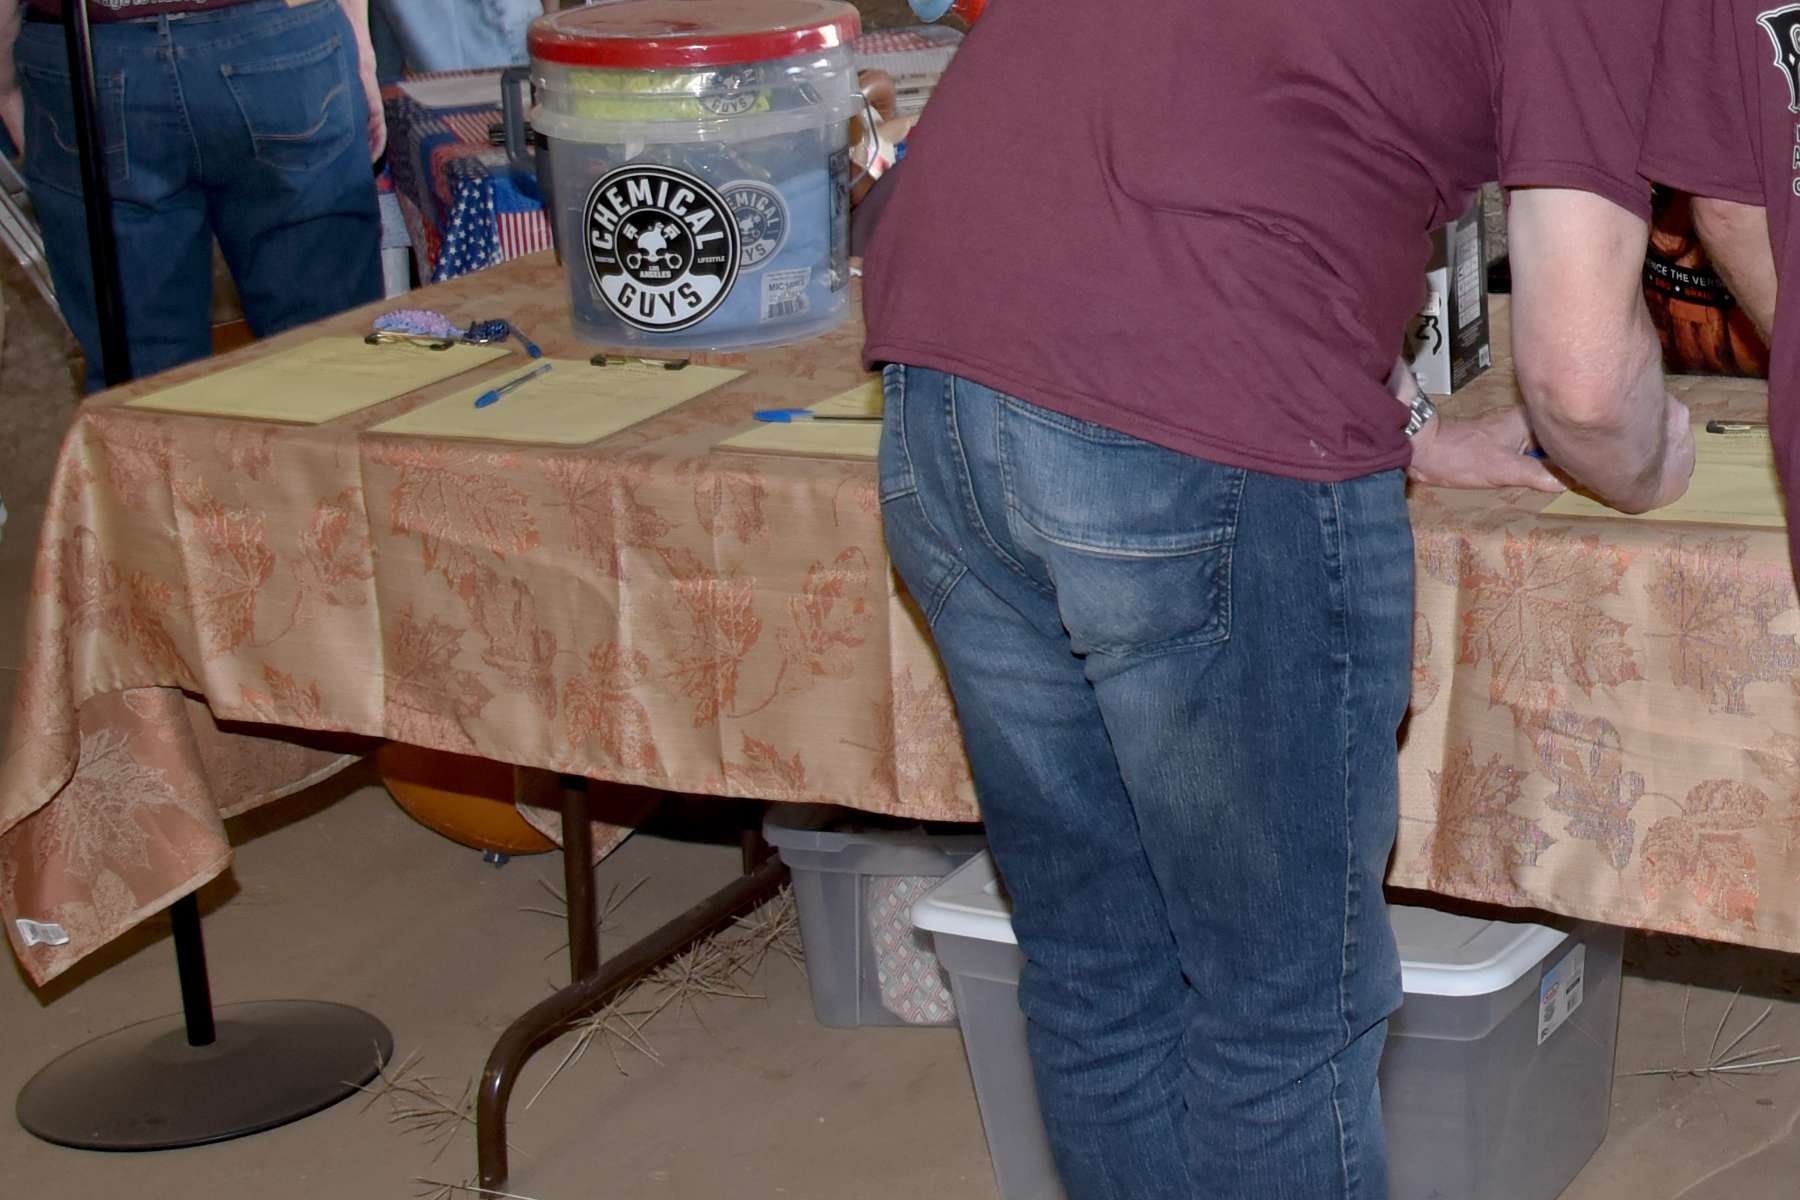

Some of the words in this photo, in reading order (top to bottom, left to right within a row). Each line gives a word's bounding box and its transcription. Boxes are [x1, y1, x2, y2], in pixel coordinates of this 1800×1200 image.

[592, 178, 724, 250] CHEMICAL
[725, 190, 781, 228] EMICAL
[744, 241, 768, 263] YS
[1671, 268, 1690, 284] THE
[618, 282, 703, 318] GUYS
